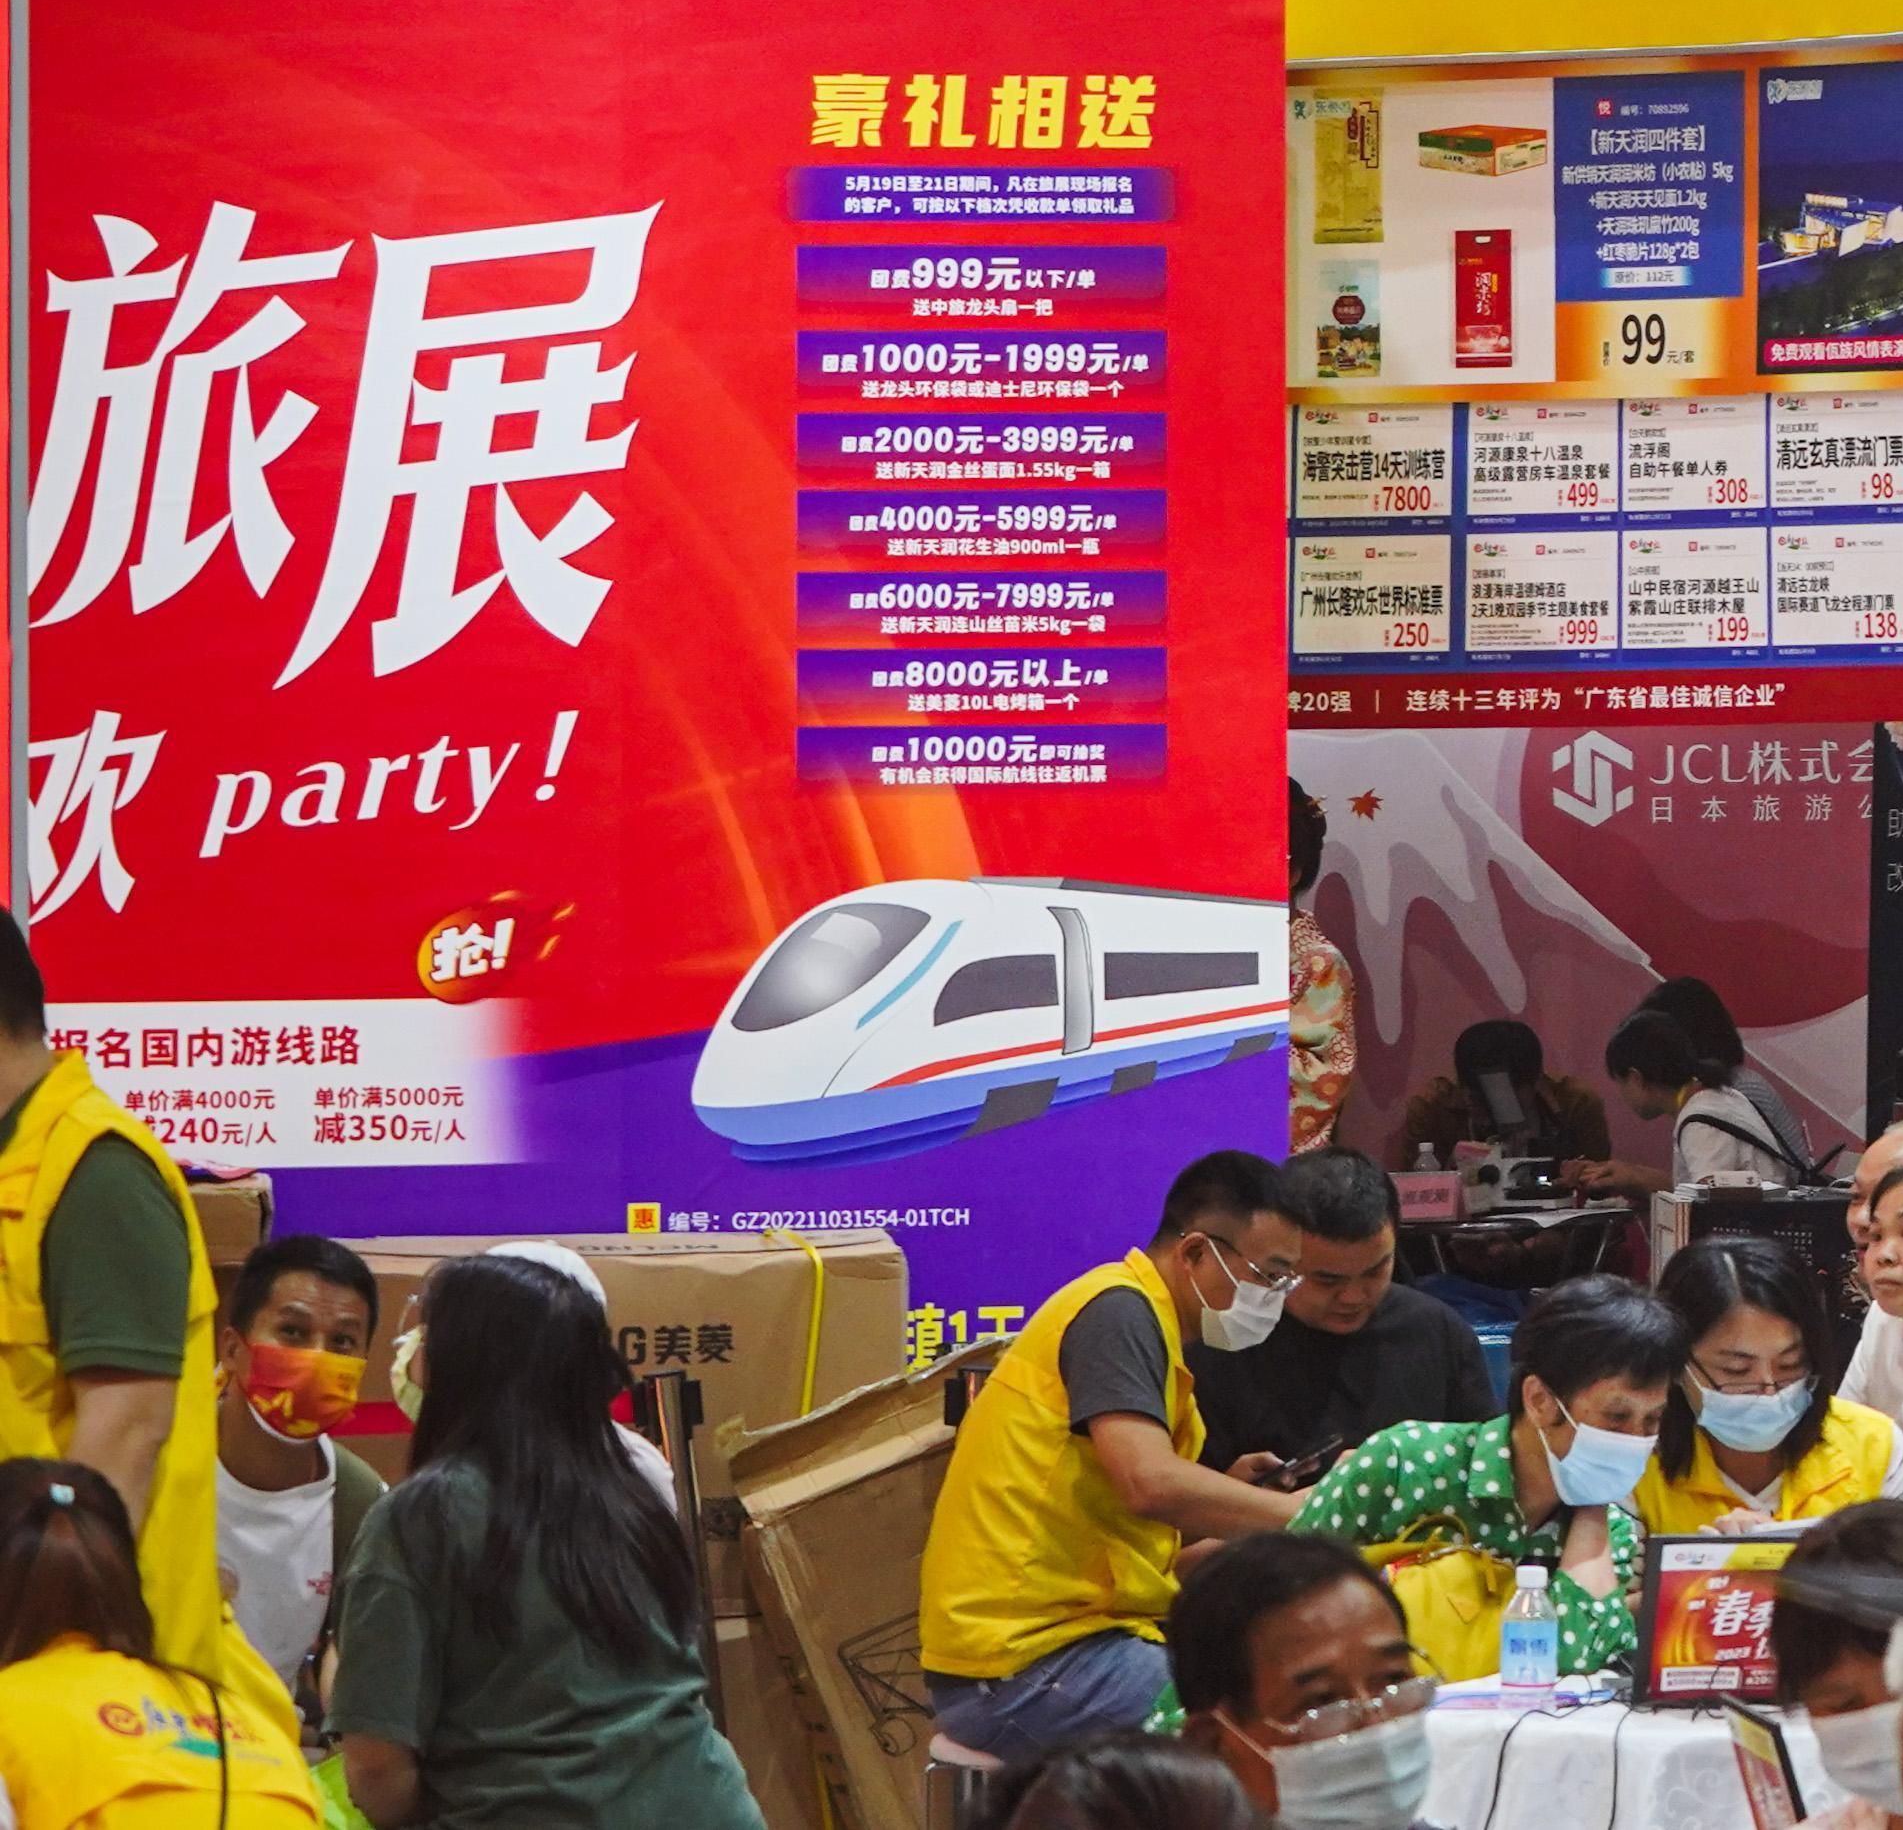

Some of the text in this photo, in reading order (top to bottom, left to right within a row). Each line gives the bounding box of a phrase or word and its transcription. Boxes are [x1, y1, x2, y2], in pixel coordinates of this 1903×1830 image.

[810, 73, 1157, 150] 豪礼相送
[1620, 312, 1667, 366] 99
[28, 199, 666, 690] 旅展
[1382, 485, 1432, 512] 7800
[1566, 481, 1599, 508] 499
[1715, 478, 1749, 504] 308
[1871, 472, 1894, 499] 98
[1393, 621, 1430, 648] 250
[1566, 619, 1599, 645] 999
[1716, 617, 1749, 642] 199
[1863, 612, 1898, 639] 138
[50, 1025, 361, 1070] 报名国内游线路
[124, 1085, 466, 1112] 单价满4000元 单价满5000元
[313, 1112, 467, 1146] 减350元/人
[654, 1323, 734, 1365] 美菱
